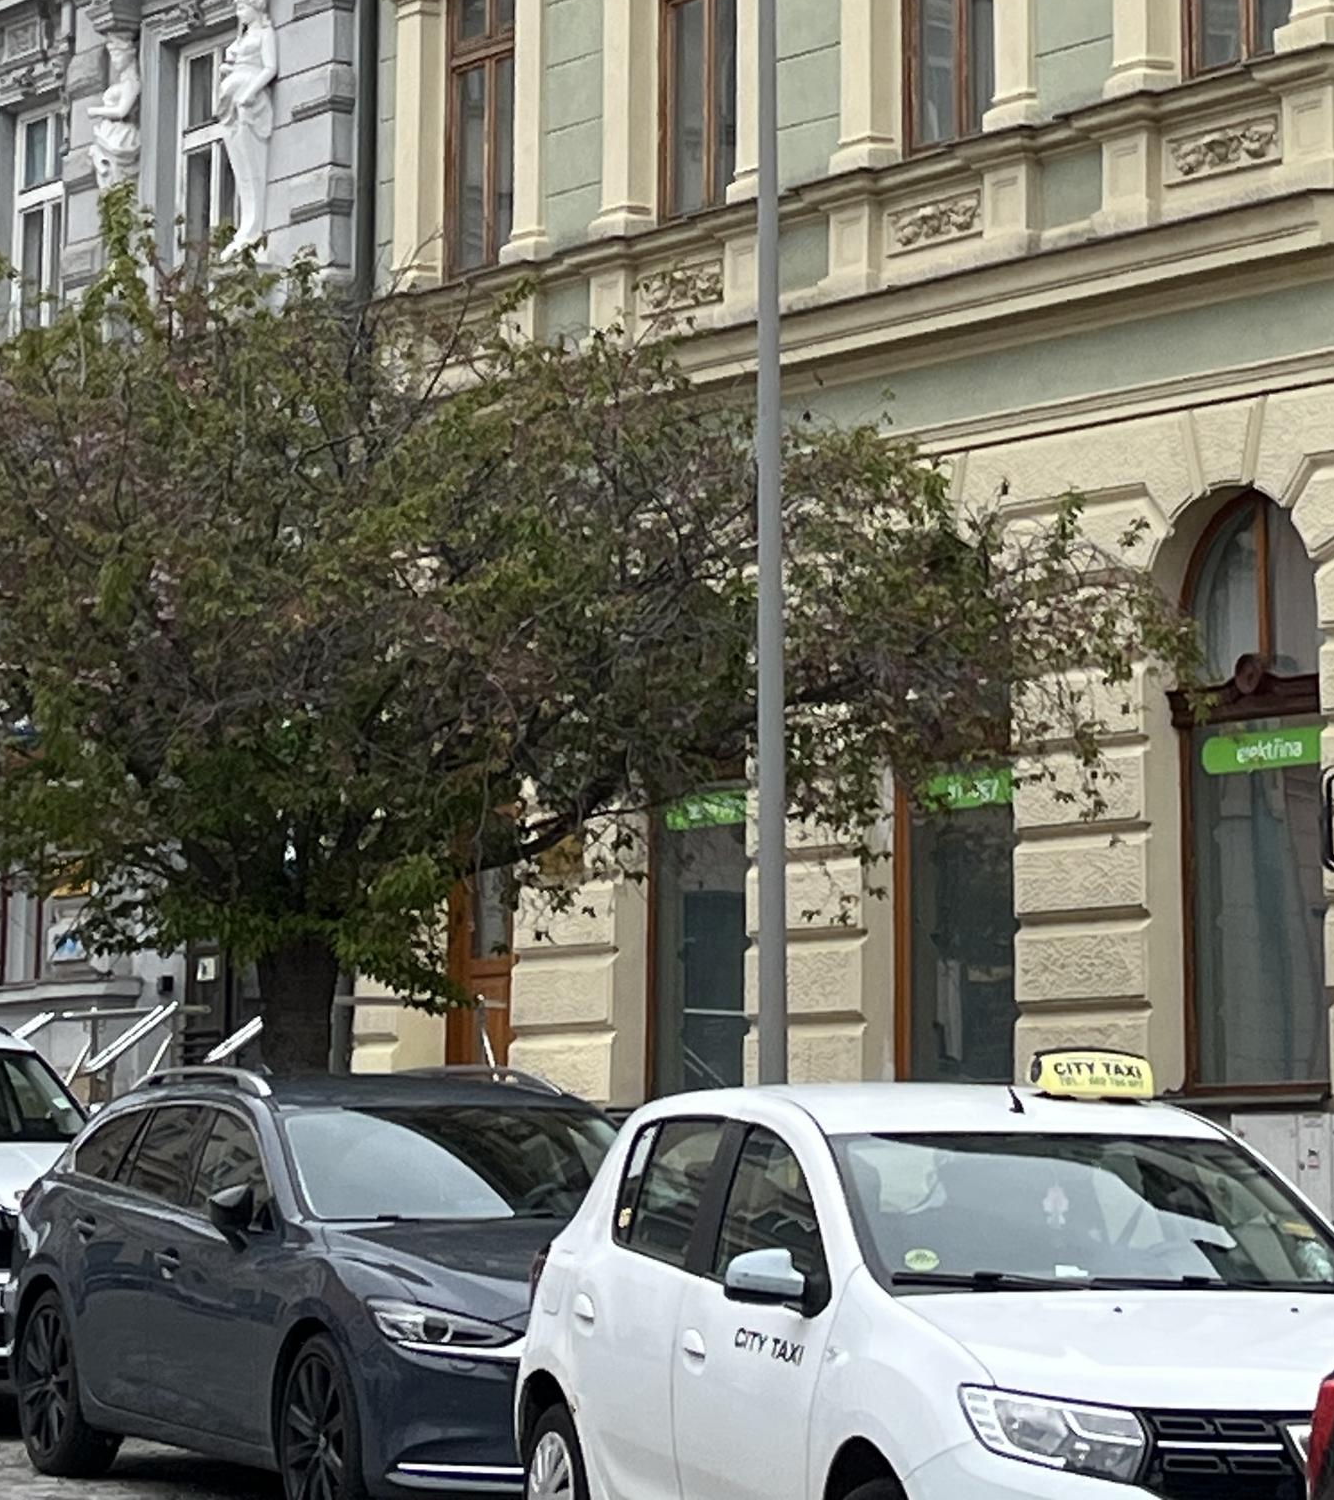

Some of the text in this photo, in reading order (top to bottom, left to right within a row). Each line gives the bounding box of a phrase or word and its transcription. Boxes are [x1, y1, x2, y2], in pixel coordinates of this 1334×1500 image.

[1053, 1062, 1143, 1079] CITY TAXI
[734, 1327, 805, 1367] CITY TAXI
